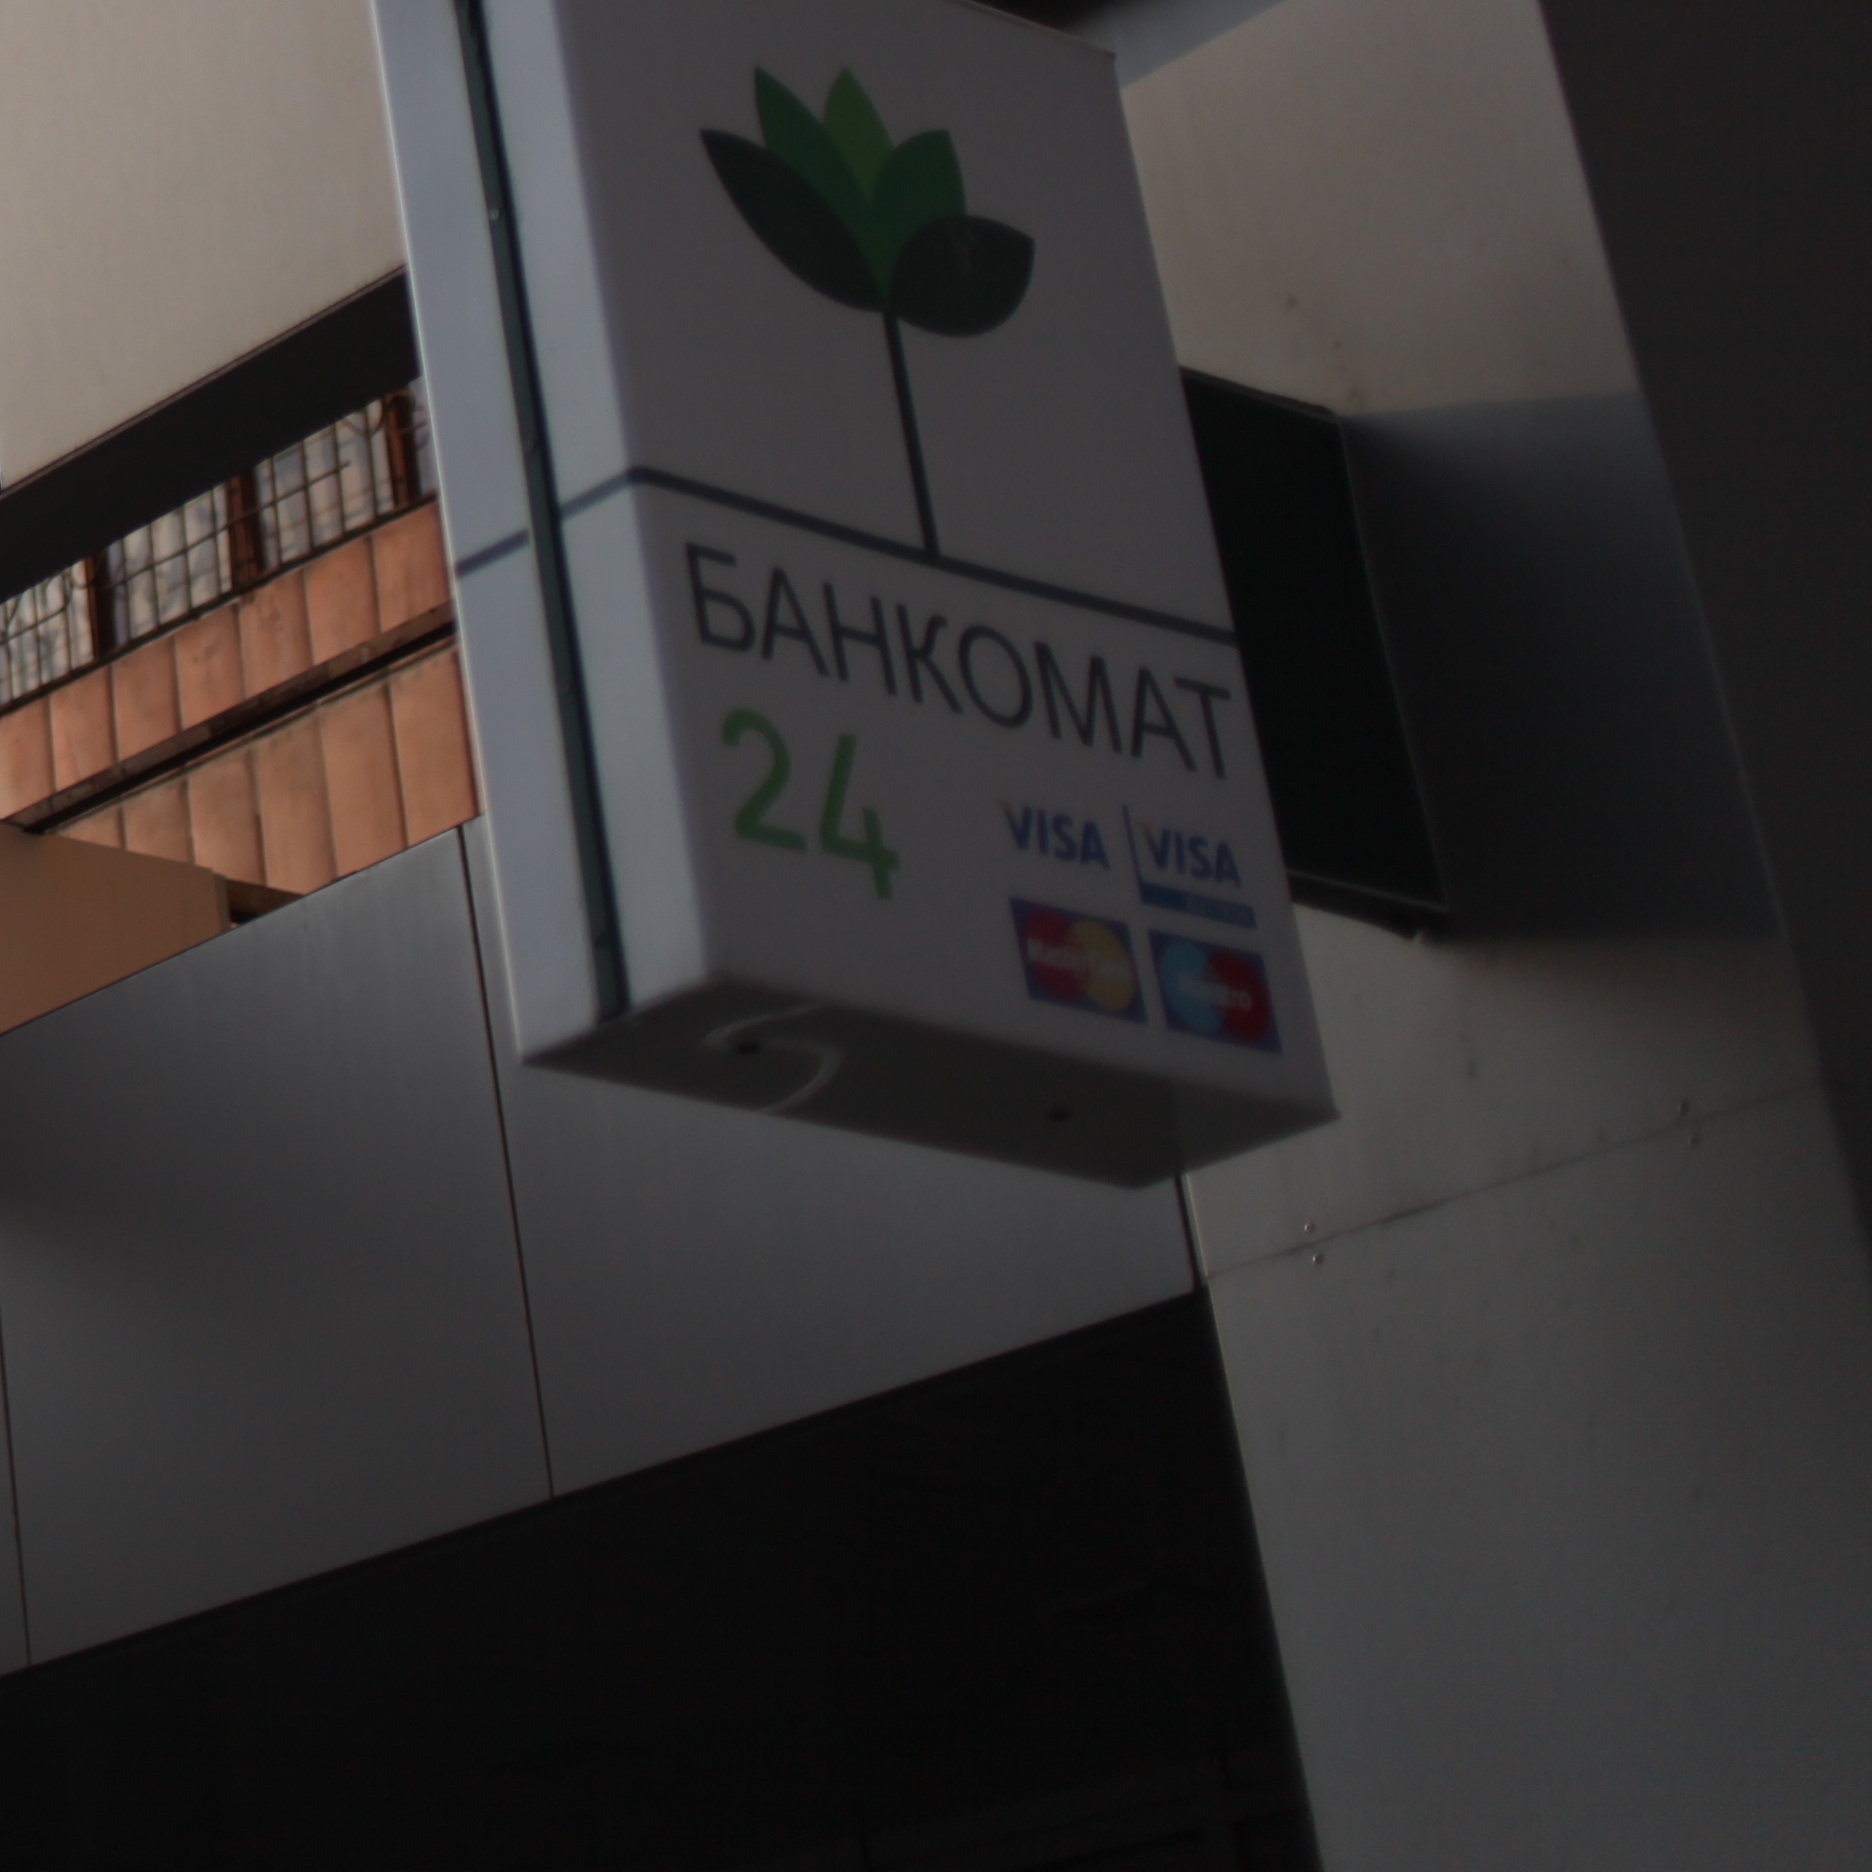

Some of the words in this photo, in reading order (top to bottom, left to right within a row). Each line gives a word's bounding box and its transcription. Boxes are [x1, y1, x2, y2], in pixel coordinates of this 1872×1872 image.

[684, 541, 1231, 780] БАНКОМАТ
[719, 707, 901, 902] 24
[998, 797, 1111, 872] VISA
[1140, 822, 1243, 888] VISA
